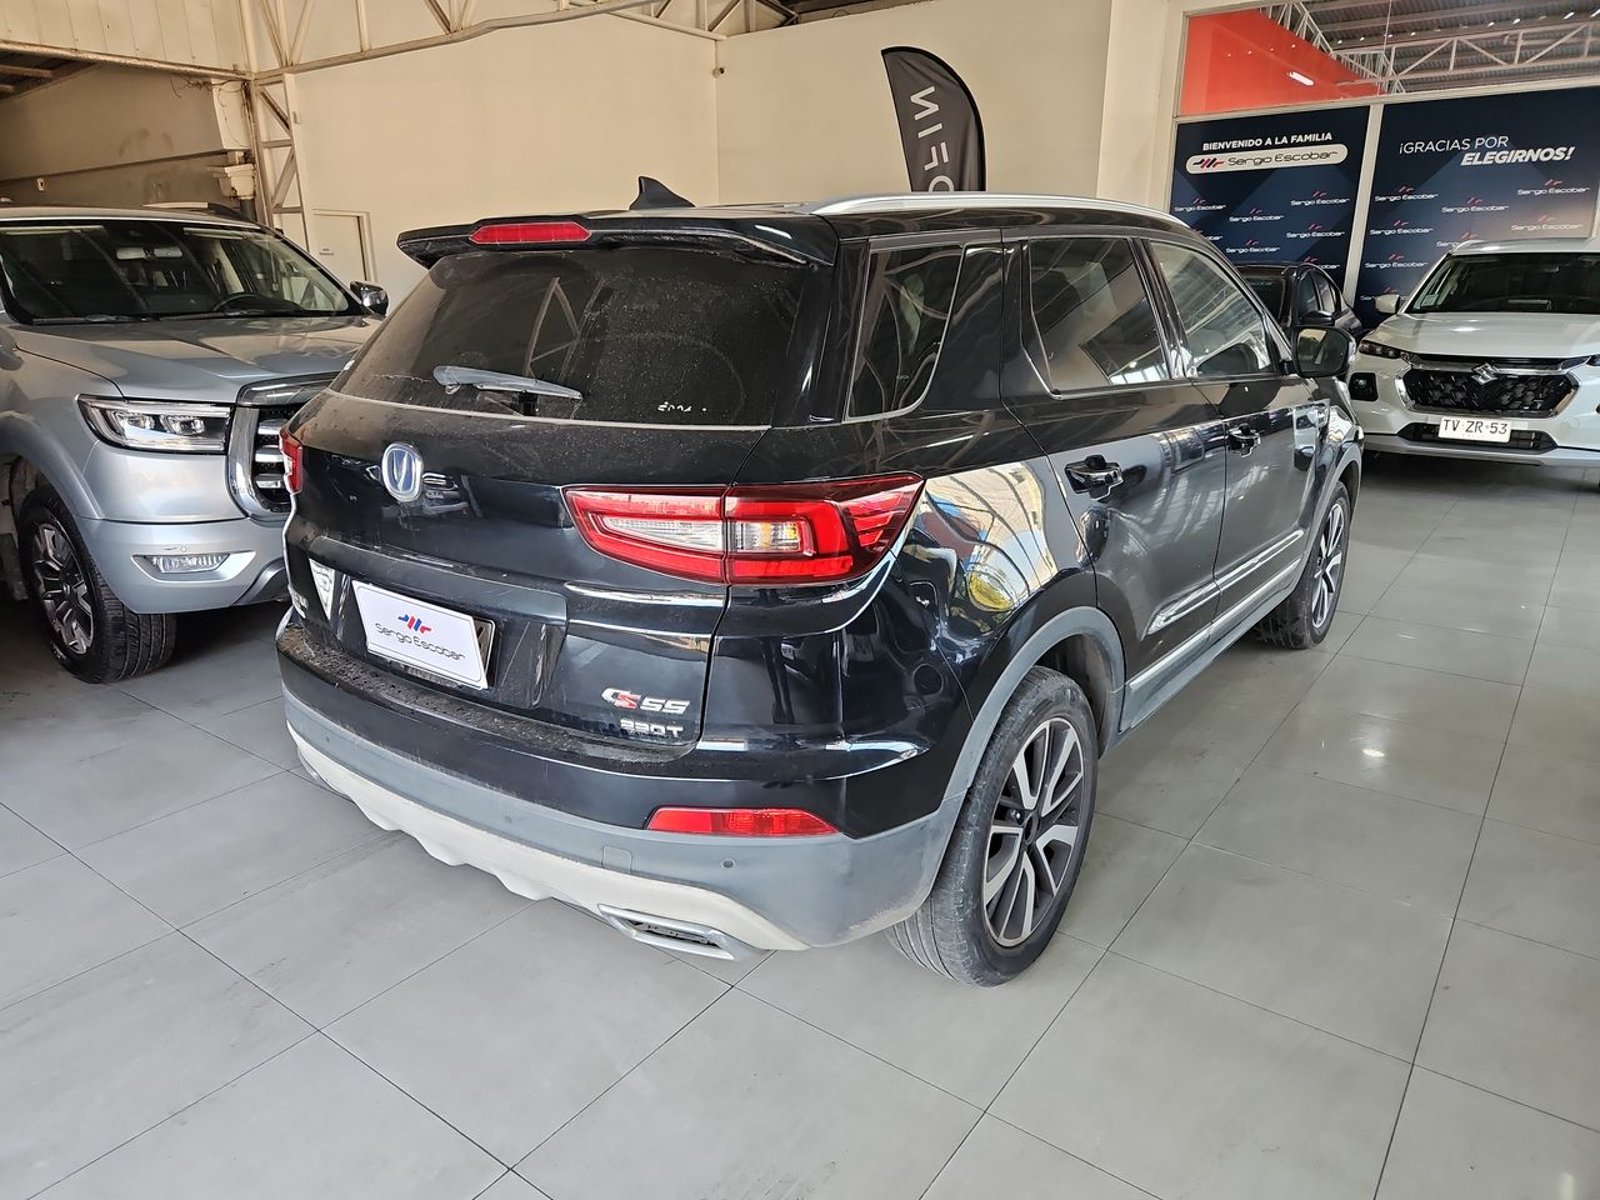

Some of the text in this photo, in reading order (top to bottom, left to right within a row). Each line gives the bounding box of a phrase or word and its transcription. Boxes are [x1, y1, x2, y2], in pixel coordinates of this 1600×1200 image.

[1202, 132, 1333, 151] BIENVENIDO A LA FAMILIA
[1399, 135, 1510, 155] ¡GRACIAS POR
[1274, 150, 1338, 163] Escobar
[1460, 146, 1575, 166] ELEGIRNOS!
[1443, 419, 1508, 435] TV ZR 53
[413, 635, 466, 662] Escobar
